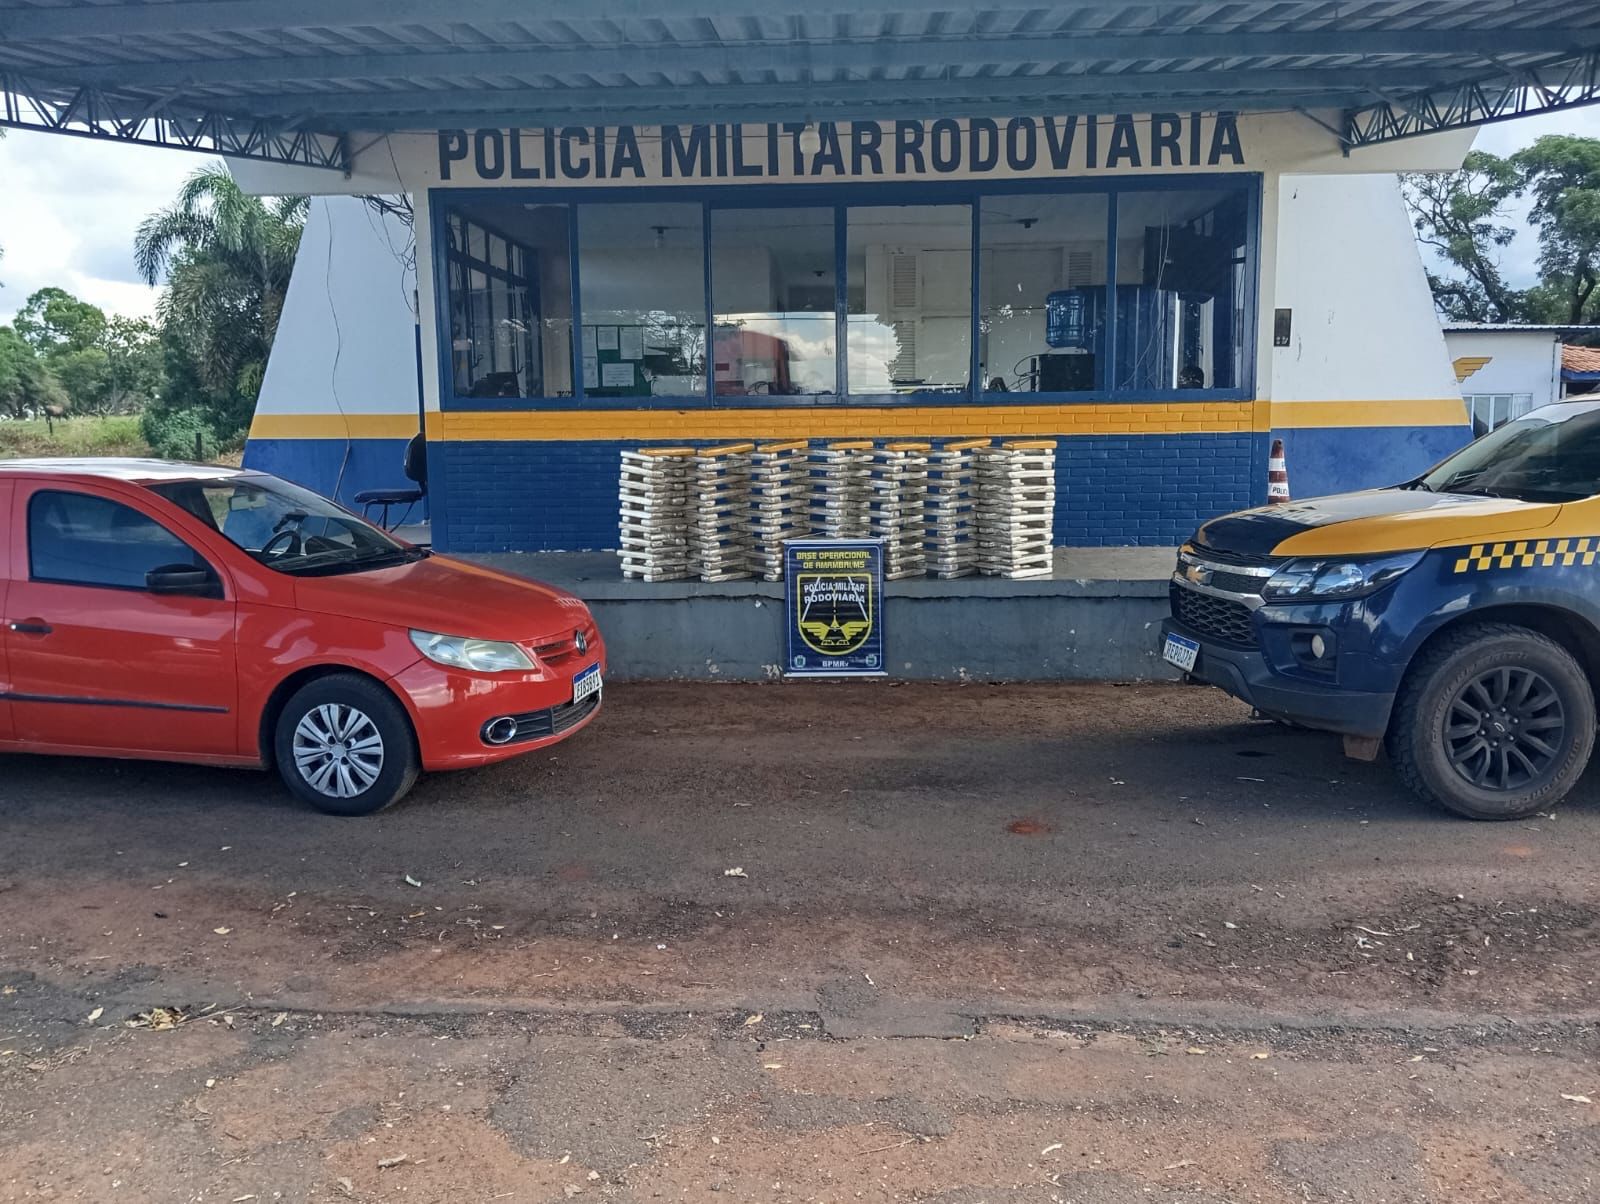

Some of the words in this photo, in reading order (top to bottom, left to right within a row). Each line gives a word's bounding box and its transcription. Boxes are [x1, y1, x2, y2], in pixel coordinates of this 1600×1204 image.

[438, 125, 646, 180] POLICIA
[661, 121, 883, 177] MILITAR
[895, 111, 1245, 174] RODOVIARIA
[796, 551, 817, 560] BASE
[819, 551, 872, 559] OPERACIONAL
[803, 561, 814, 569] DE
[834, 582, 865, 593] MILITAR
